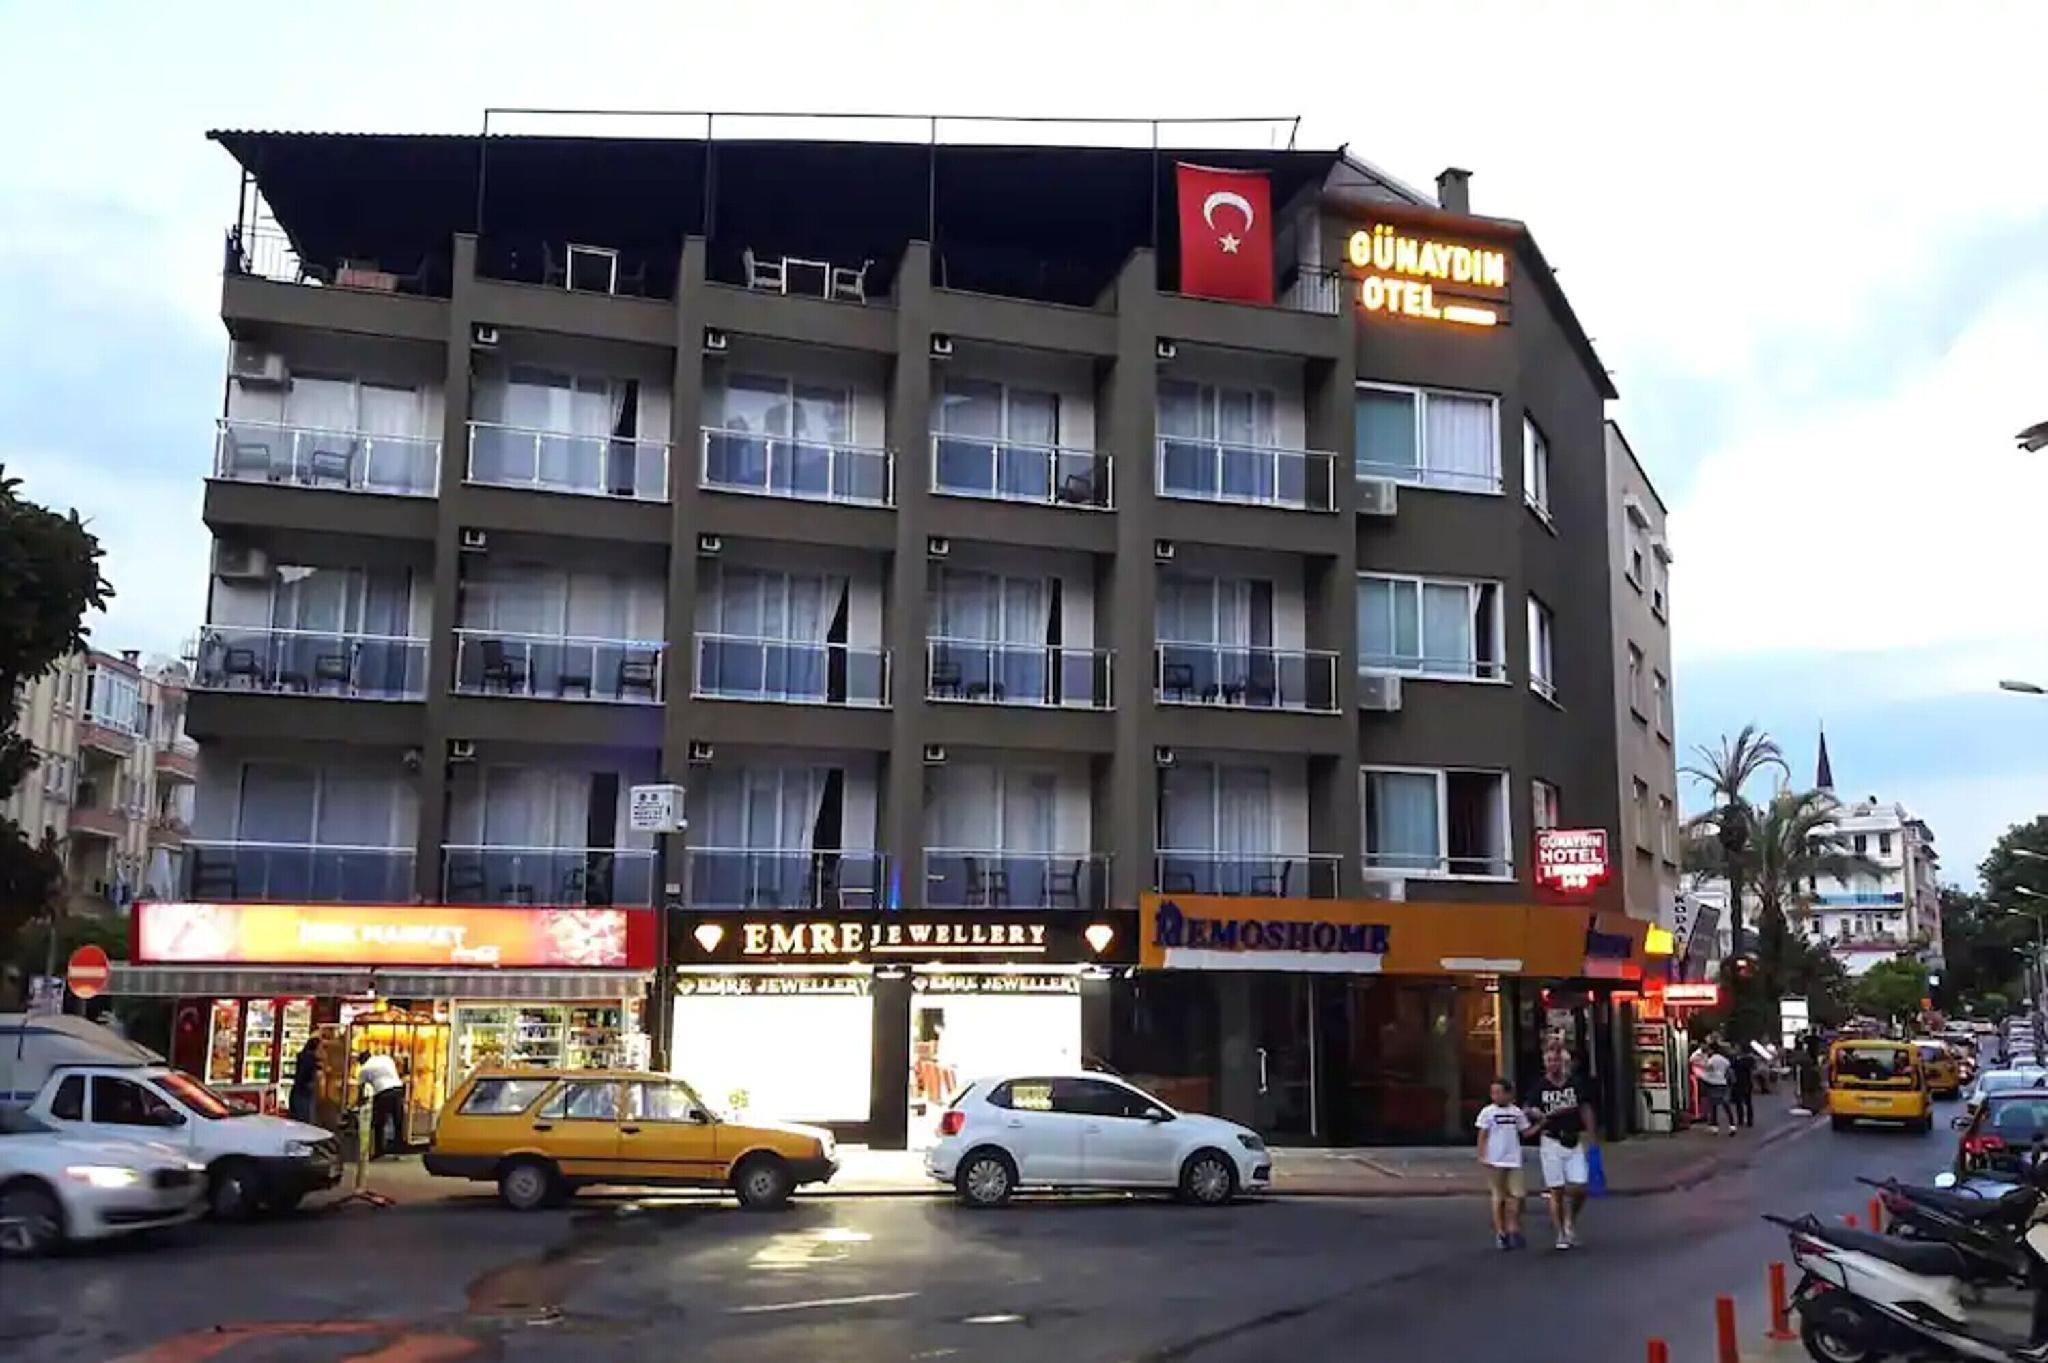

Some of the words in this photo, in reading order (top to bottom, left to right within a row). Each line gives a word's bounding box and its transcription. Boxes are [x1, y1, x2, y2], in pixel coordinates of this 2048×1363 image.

[1349, 223, 1505, 287] GÜNAYDIN
[1362, 275, 1442, 319] OTEL
[1540, 848, 1603, 863] HOTEL
[742, 922, 864, 954] EMRE
[869, 923, 1046, 946] JEWELLERY
[696, 977, 752, 996] EMRE
[756, 977, 872, 997] JEWELLERY
